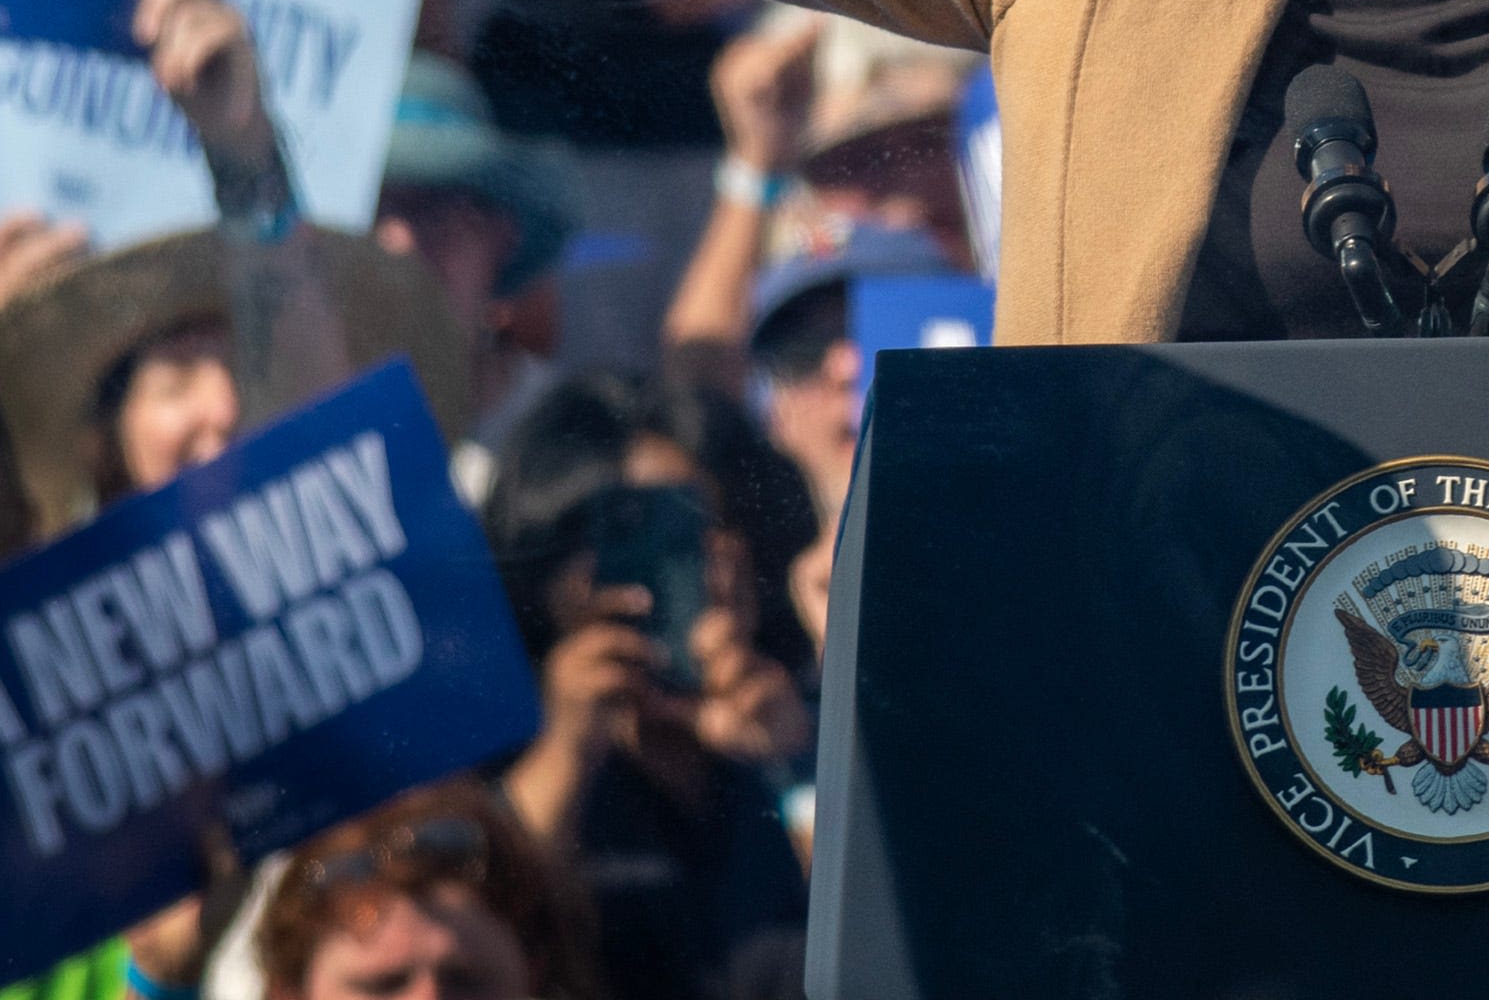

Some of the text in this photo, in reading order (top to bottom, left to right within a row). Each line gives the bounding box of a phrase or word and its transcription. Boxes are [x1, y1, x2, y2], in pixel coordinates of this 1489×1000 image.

[7, 428, 409, 726] NEW WAY
[1370, 479, 1417, 515] OF
[10, 566, 425, 857] FORWARD
[1238, 502, 1349, 758] PRESIDENT
[1277, 772, 1375, 869] VICE
